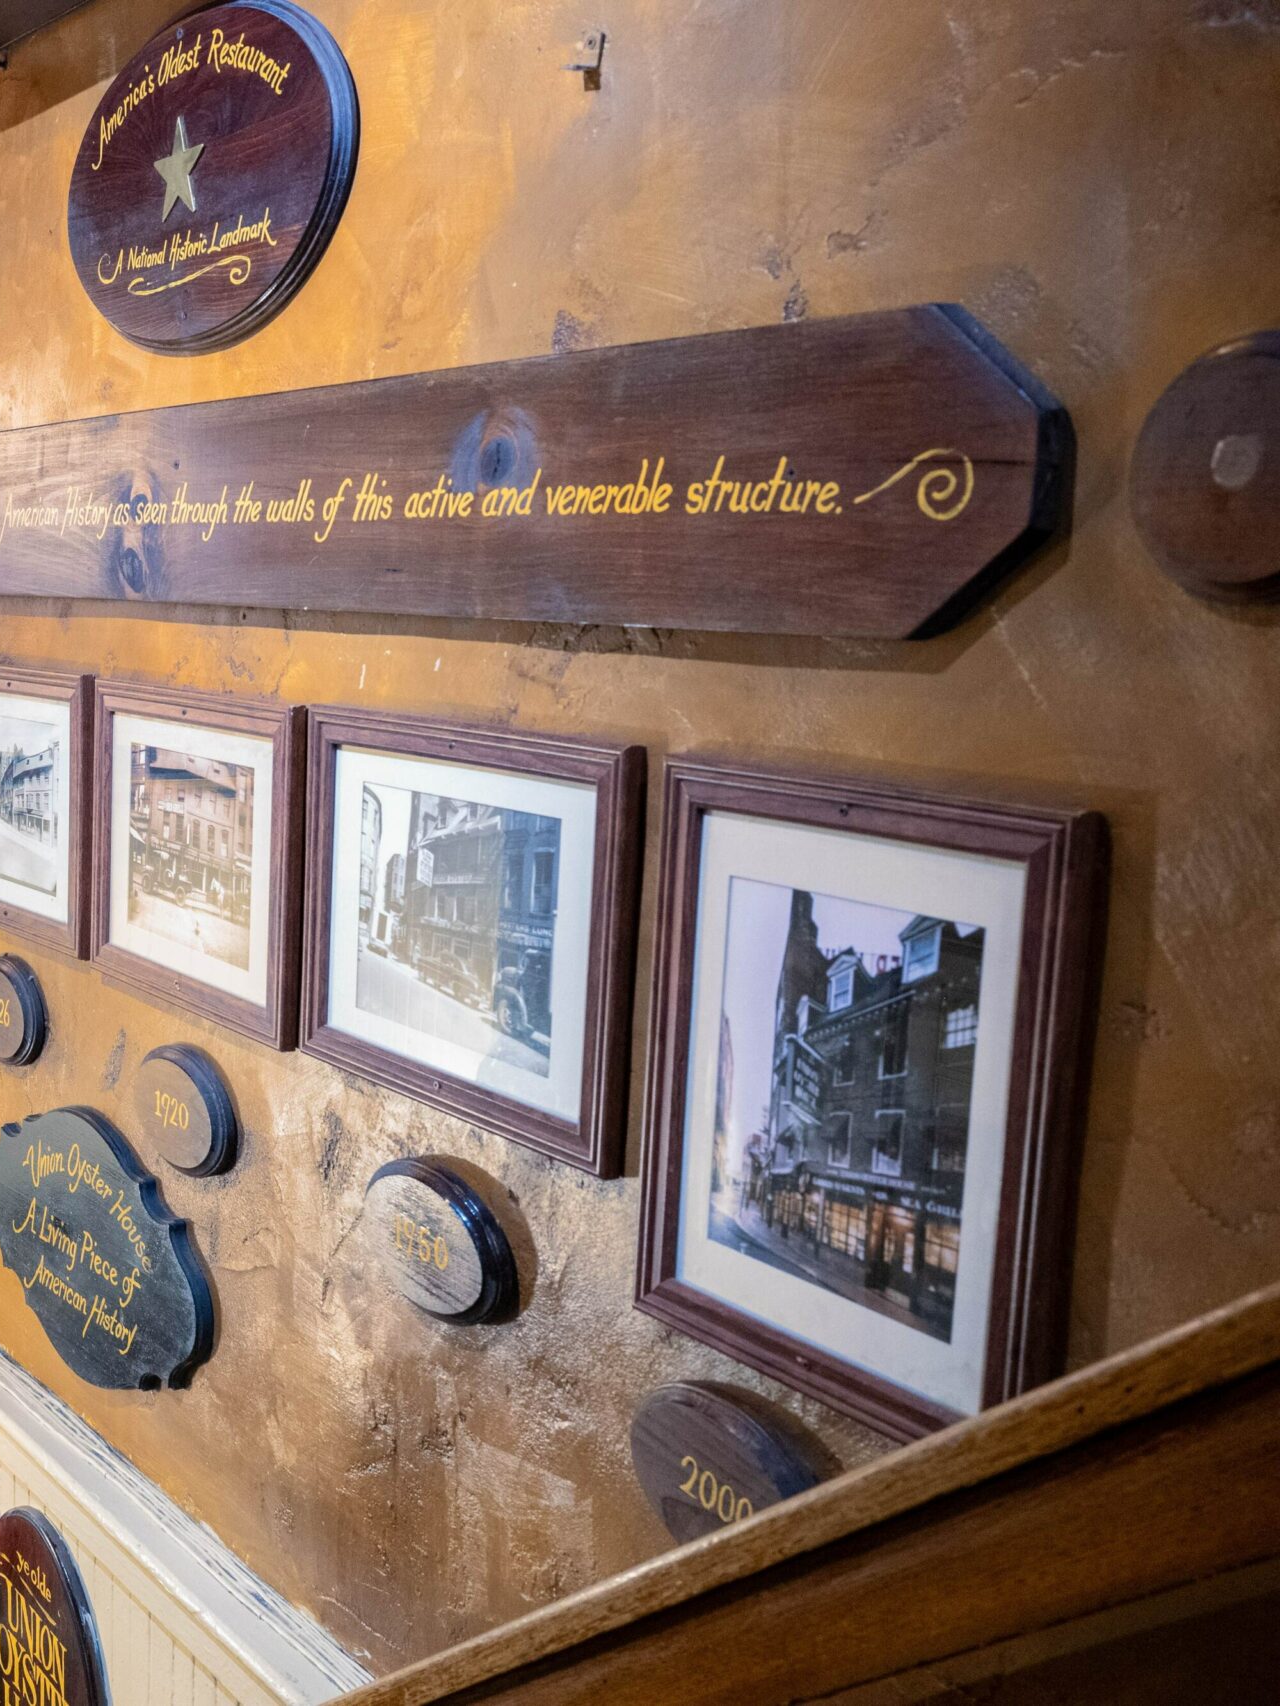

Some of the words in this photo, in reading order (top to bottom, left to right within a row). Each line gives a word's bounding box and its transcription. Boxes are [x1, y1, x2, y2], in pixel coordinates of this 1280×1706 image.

[92, 65, 154, 170] America's
[158, 34, 202, 87] Oldest
[207, 28, 291, 95] Restaurant
[98, 249, 123, 285] A
[127, 240, 167, 271] National
[169, 230, 207, 271] Historic
[208, 207, 277, 254] Landmark
[61, 486, 112, 540] History
[112, 502, 131, 526] as
[135, 499, 168, 525] seen
[170, 482, 228, 542] through
[233, 481, 260, 524] the
[266, 479, 316, 523] walls
[314, 478, 352, 543] of
[353, 473, 393, 522] this
[405, 474, 472, 519] active
[481, 468, 542, 518] and
[546, 457, 671, 516] venerable
[685, 455, 843, 516] structure.
[154, 1088, 189, 1130] 1920
[23, 1140, 65, 1187] Union
[67, 1143, 112, 1199] Oyster
[109, 1190, 154, 1274] House
[394, 1214, 449, 1271] 1950
[13, 1197, 36, 1234] A
[39, 1206, 77, 1271] Living
[79, 1230, 118, 1286] Piece
[120, 1267, 141, 1307] of
[24, 1255, 87, 1314] American
[82, 1295, 138, 1355] History
[679, 1455, 753, 1523] 2000
[16, 1551, 30, 1576] ye
[31, 1565, 52, 1603] olde
